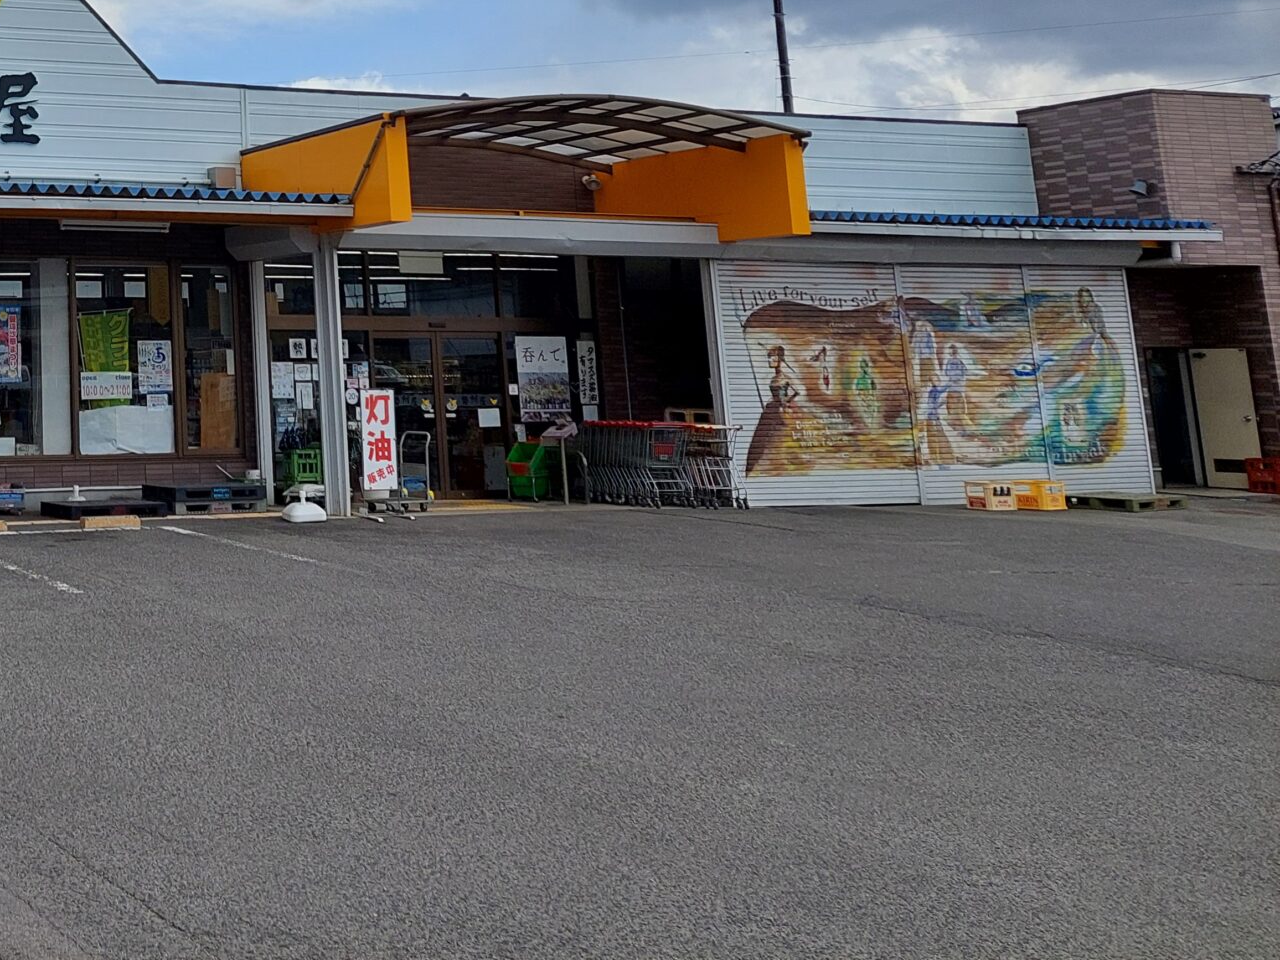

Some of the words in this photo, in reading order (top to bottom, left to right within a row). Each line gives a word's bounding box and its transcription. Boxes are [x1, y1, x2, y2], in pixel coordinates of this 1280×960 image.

[739, 288, 778, 313] Live
[783, 286, 808, 300] for
[365, 394, 392, 462] 灯油
[367, 464, 395, 484] 販売中
